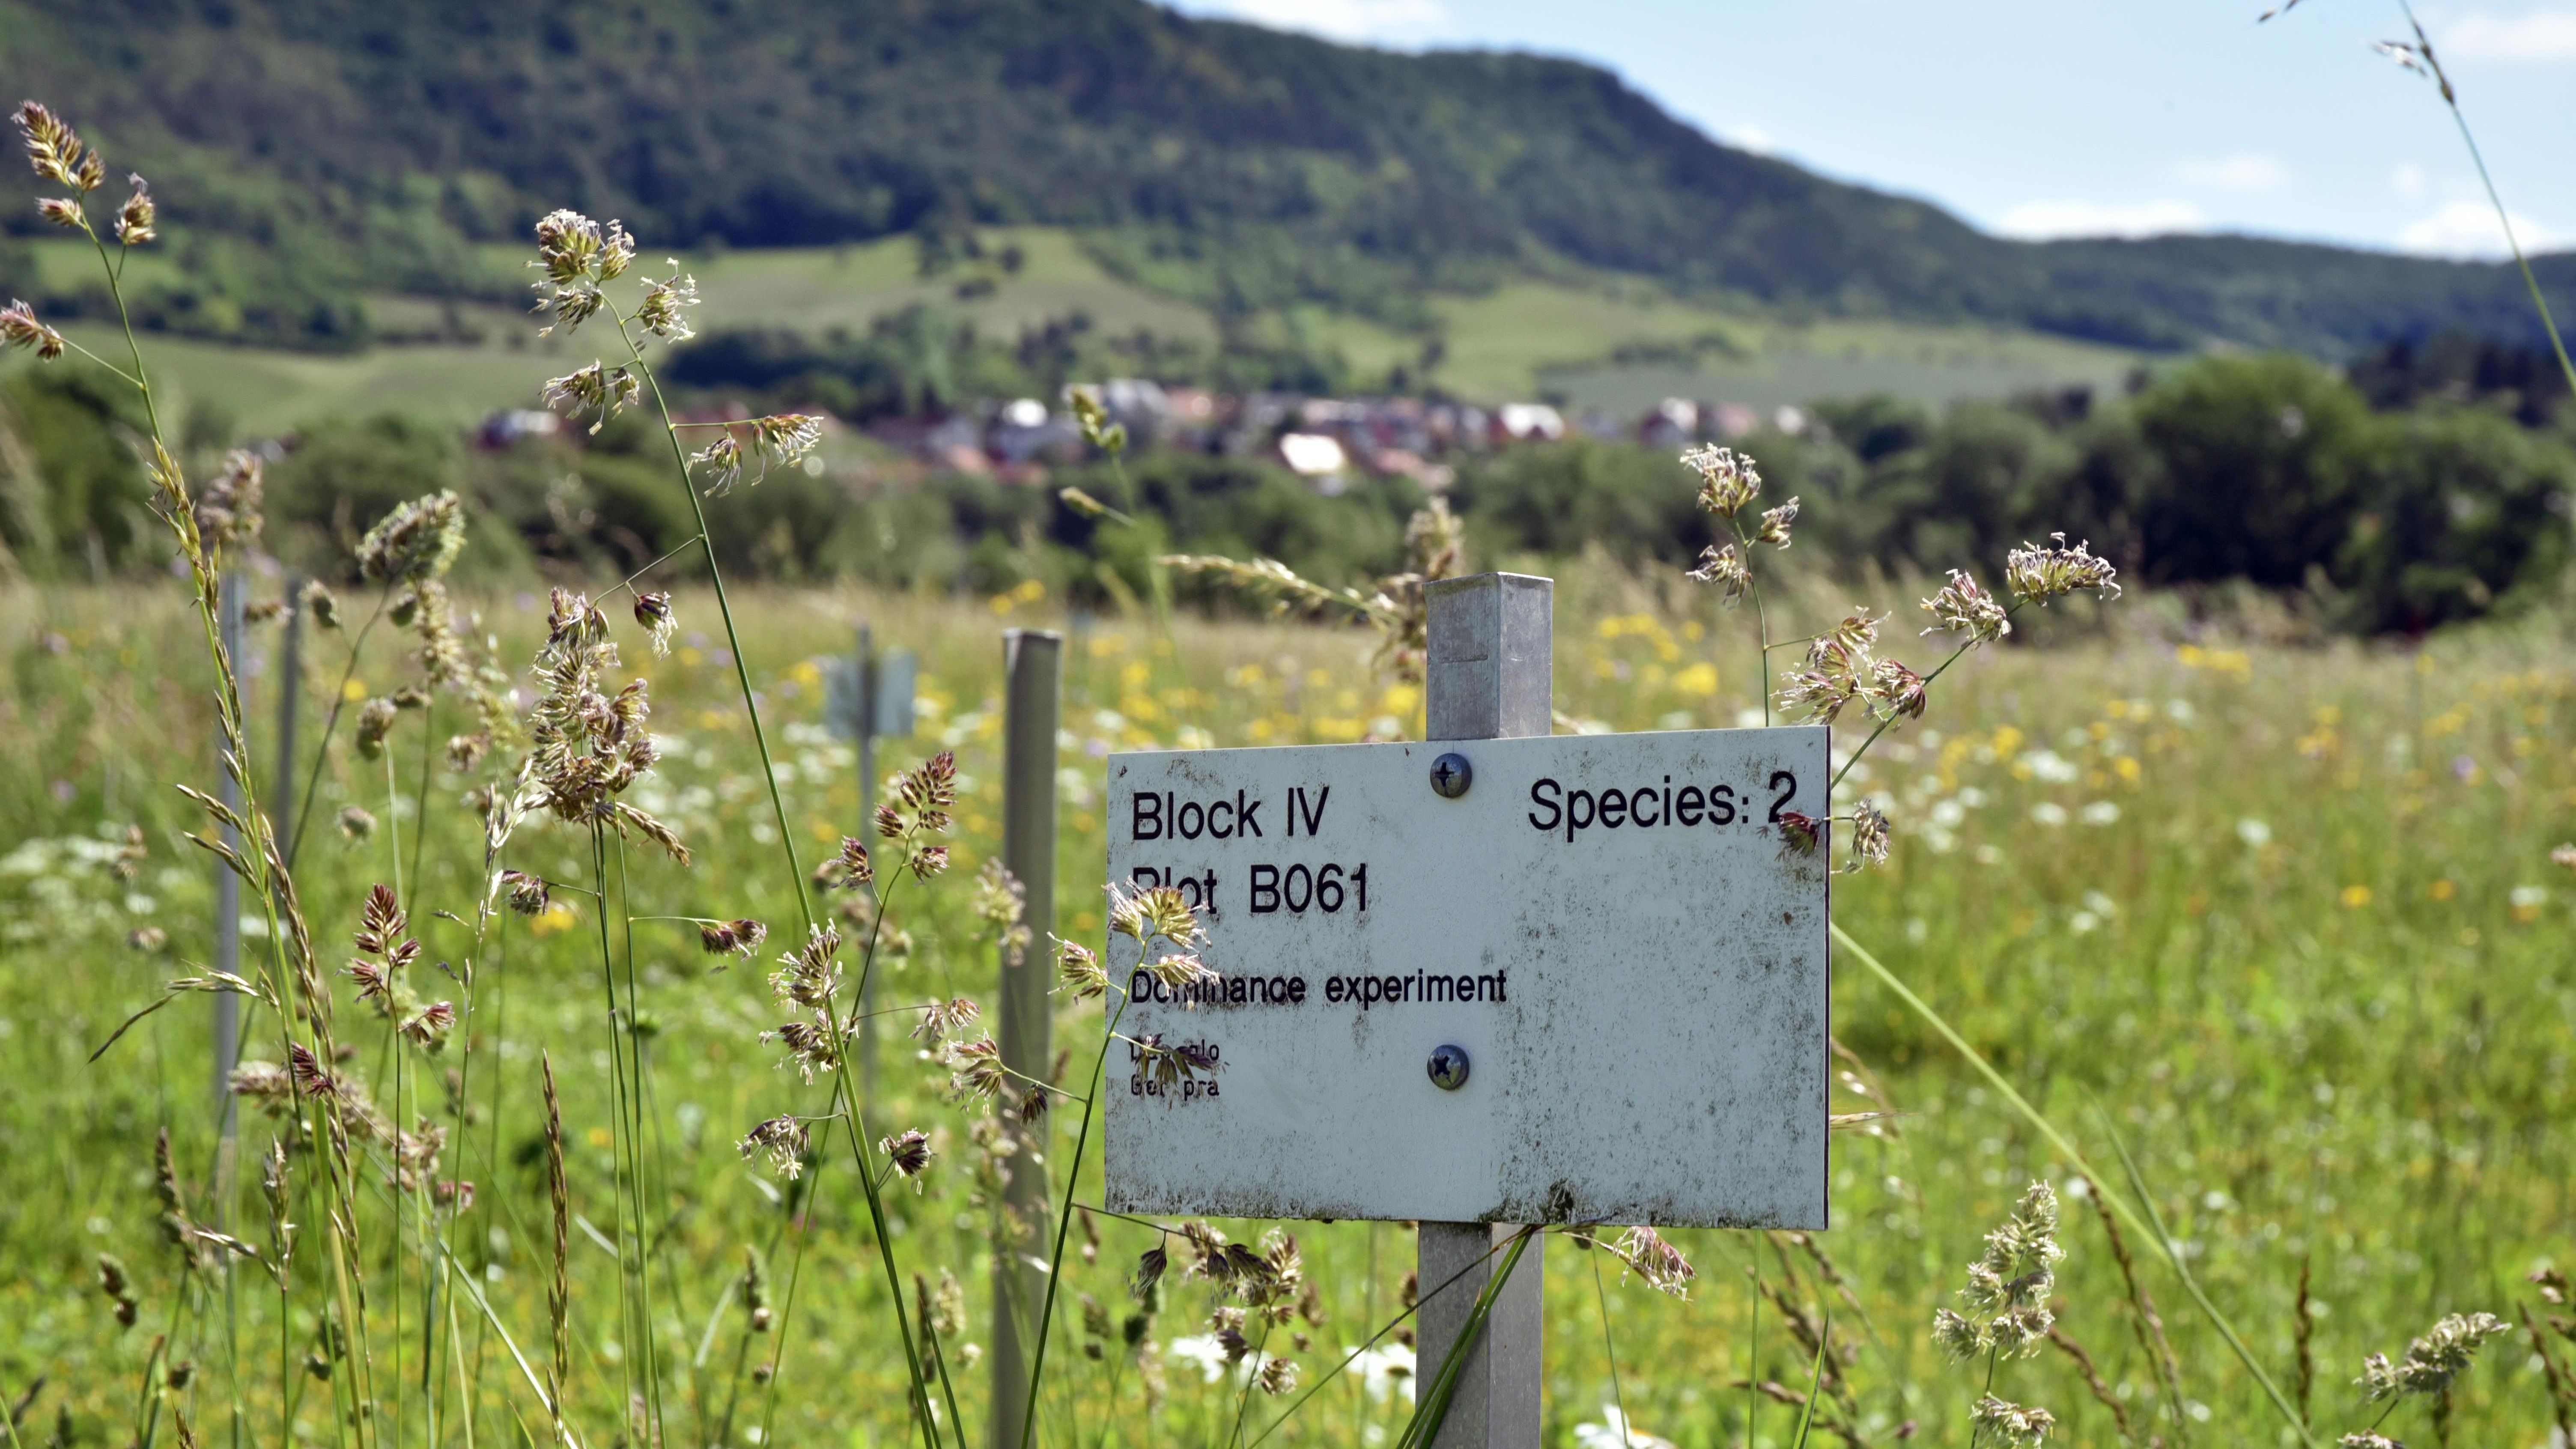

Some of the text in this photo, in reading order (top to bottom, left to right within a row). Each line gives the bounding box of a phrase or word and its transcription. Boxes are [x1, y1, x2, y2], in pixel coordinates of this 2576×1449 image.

[1133, 786, 1330, 840] Block IV
[1529, 770, 1797, 843] Species: 2
[1250, 863, 1366, 913] B061
[1325, 969, 1507, 1011] experiment
[1184, 1080, 1219, 1101] pra
